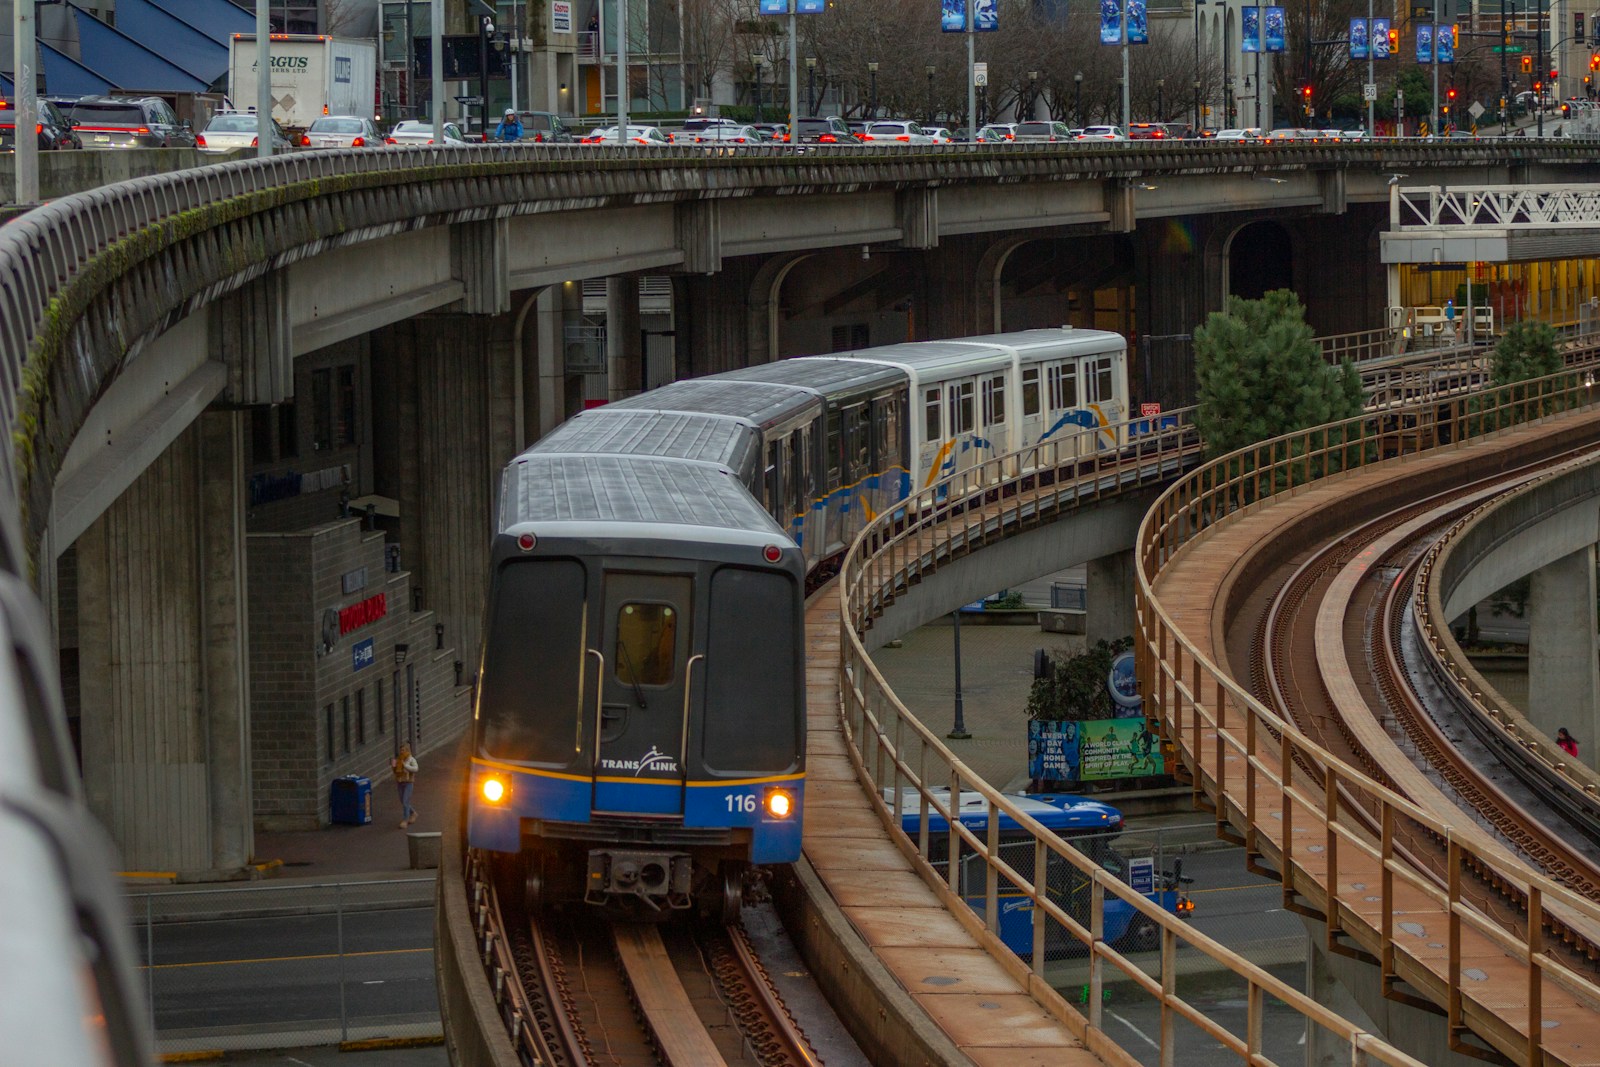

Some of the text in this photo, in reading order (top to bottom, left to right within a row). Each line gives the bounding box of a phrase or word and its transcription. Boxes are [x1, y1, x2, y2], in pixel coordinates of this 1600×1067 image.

[1365, 88, 1376, 97] 50
[1084, 748, 1120, 756] COMMUNITY
[1084, 754, 1111, 762] INSPIRED
[724, 794, 756, 813] 116
